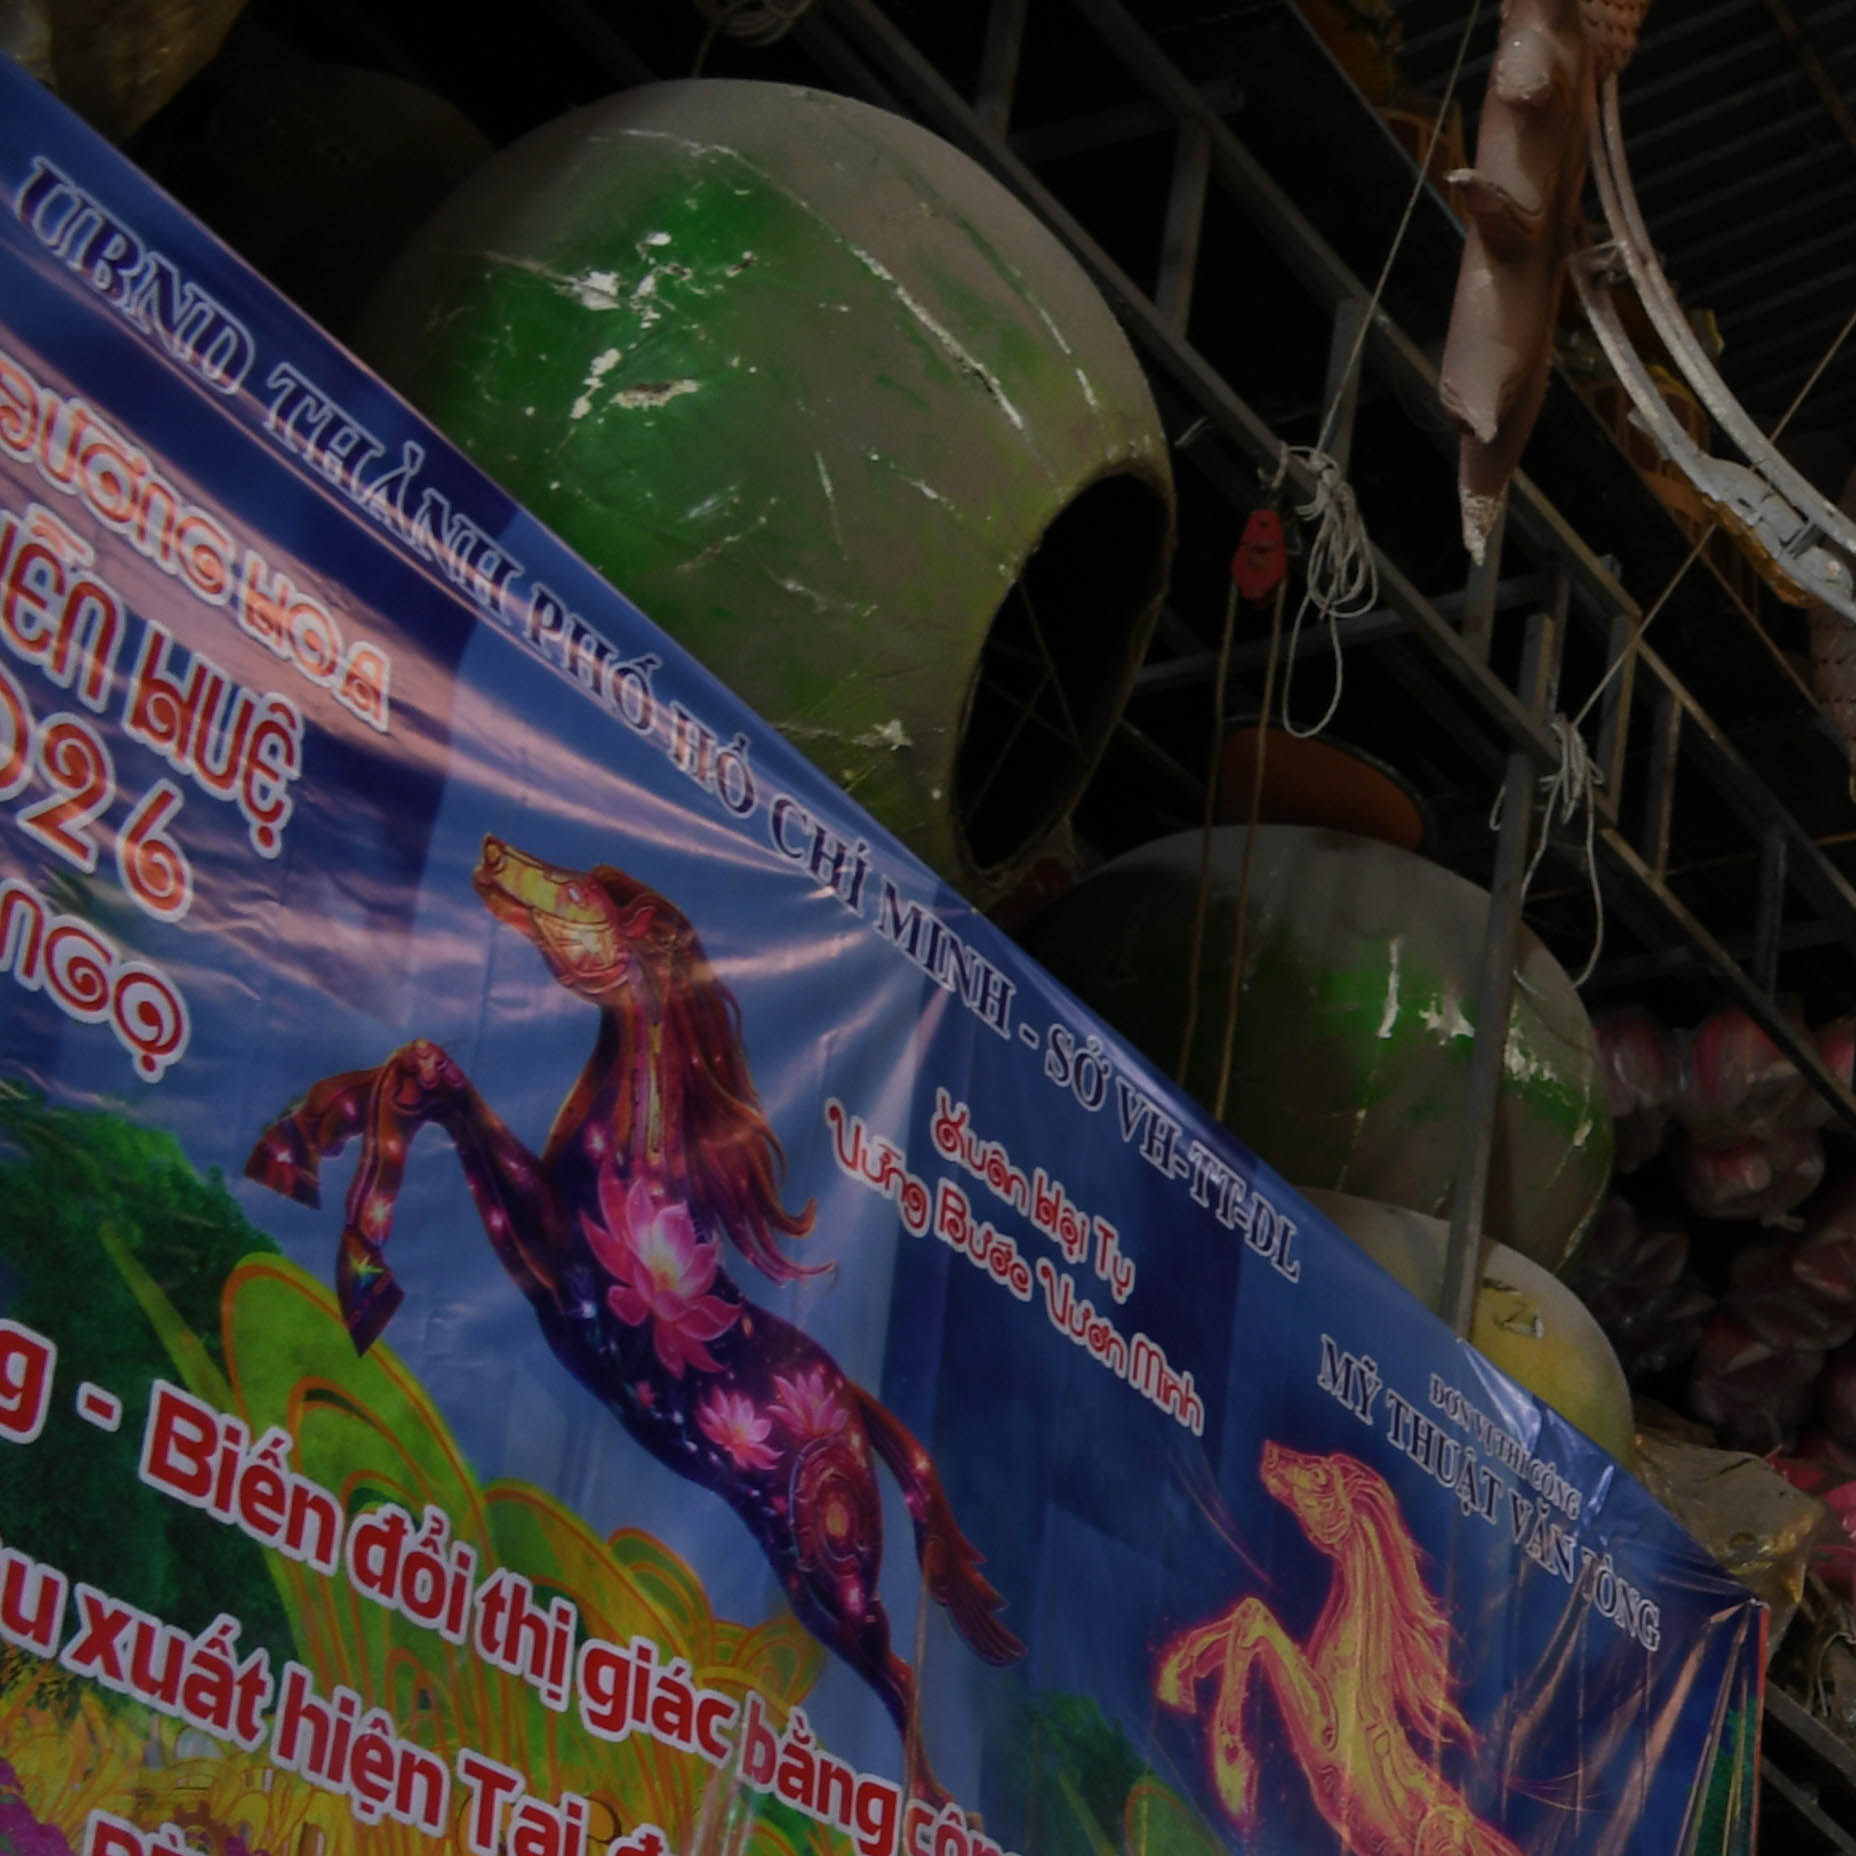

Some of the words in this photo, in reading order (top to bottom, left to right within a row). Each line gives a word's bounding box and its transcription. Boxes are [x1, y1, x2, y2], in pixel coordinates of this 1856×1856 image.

[14, 156, 254, 395] UBND
[264, 363, 523, 626] THÀNH
[523, 582, 661, 735] PHỐ
[666, 699, 756, 818] HỒ
[771, 794, 873, 915] CHÍ
[874, 879, 1016, 1040] MINH
[1044, 1023, 1110, 1110] SỞ
[122, 619, 306, 858] HUỆ
[238, 550, 391, 733] HOA
[826, 1098, 931, 1238] Vững
[1036, 1257, 1128, 1380] Vươn
[1031, 1168, 1089, 1264] Hội
[1093, 1214, 1136, 1304] Tụ
[1317, 1333, 1383, 1426] MỸ
[1385, 1389, 1504, 1525] THUẬT
[1528, 1457, 1582, 1521] CÔNG
[138, 1379, 345, 1576] Biến
[347, 1503, 478, 1645] đổi
[475, 1566, 577, 1713] thị
[577, 1634, 741, 1773] giác
[60, 1582, 275, 1752] xuất
[271, 1661, 453, 1841] hiện
